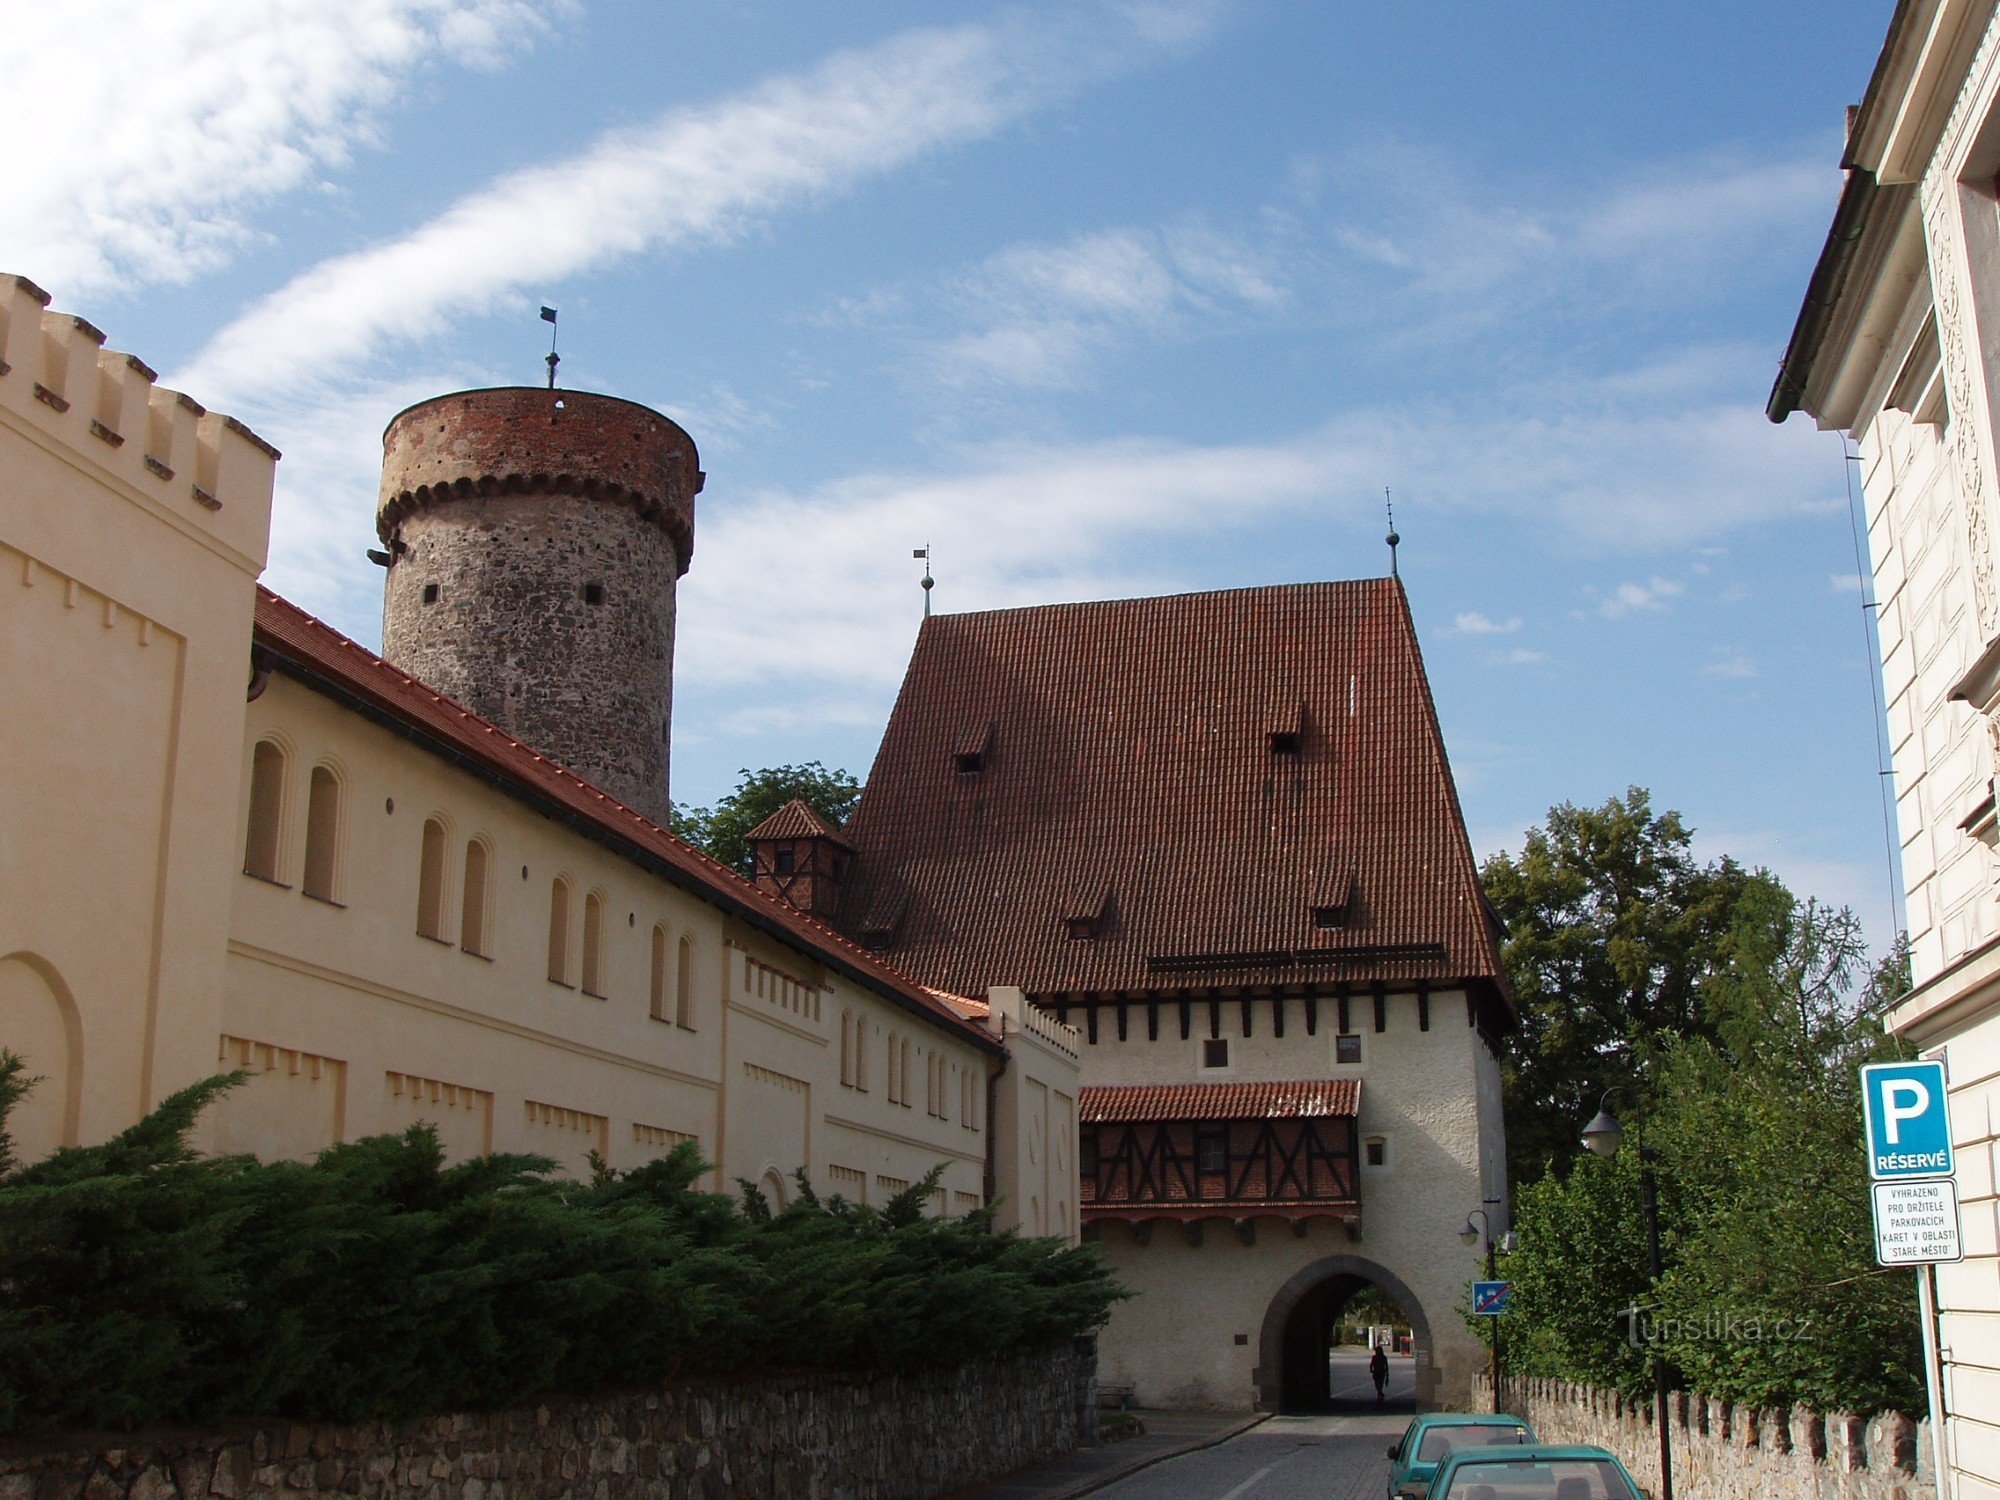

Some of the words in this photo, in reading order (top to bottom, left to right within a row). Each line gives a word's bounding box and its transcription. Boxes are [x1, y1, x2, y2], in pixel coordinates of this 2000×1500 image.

[1880, 1079, 1929, 1144] P
[1877, 1150, 1947, 1170] RÉSERVÉ
[1891, 1187, 1938, 1198] VYHRAZENO
[1888, 1203, 1904, 1213] PRO
[1907, 1201, 1944, 1212] DRŽITELE
[1891, 1215, 1944, 1228] PARKOVACÍCH
[1882, 1232, 1908, 1243] KARET
[1912, 1232, 1918, 1241] V
[1922, 1230, 1955, 1241] OBLASTI
